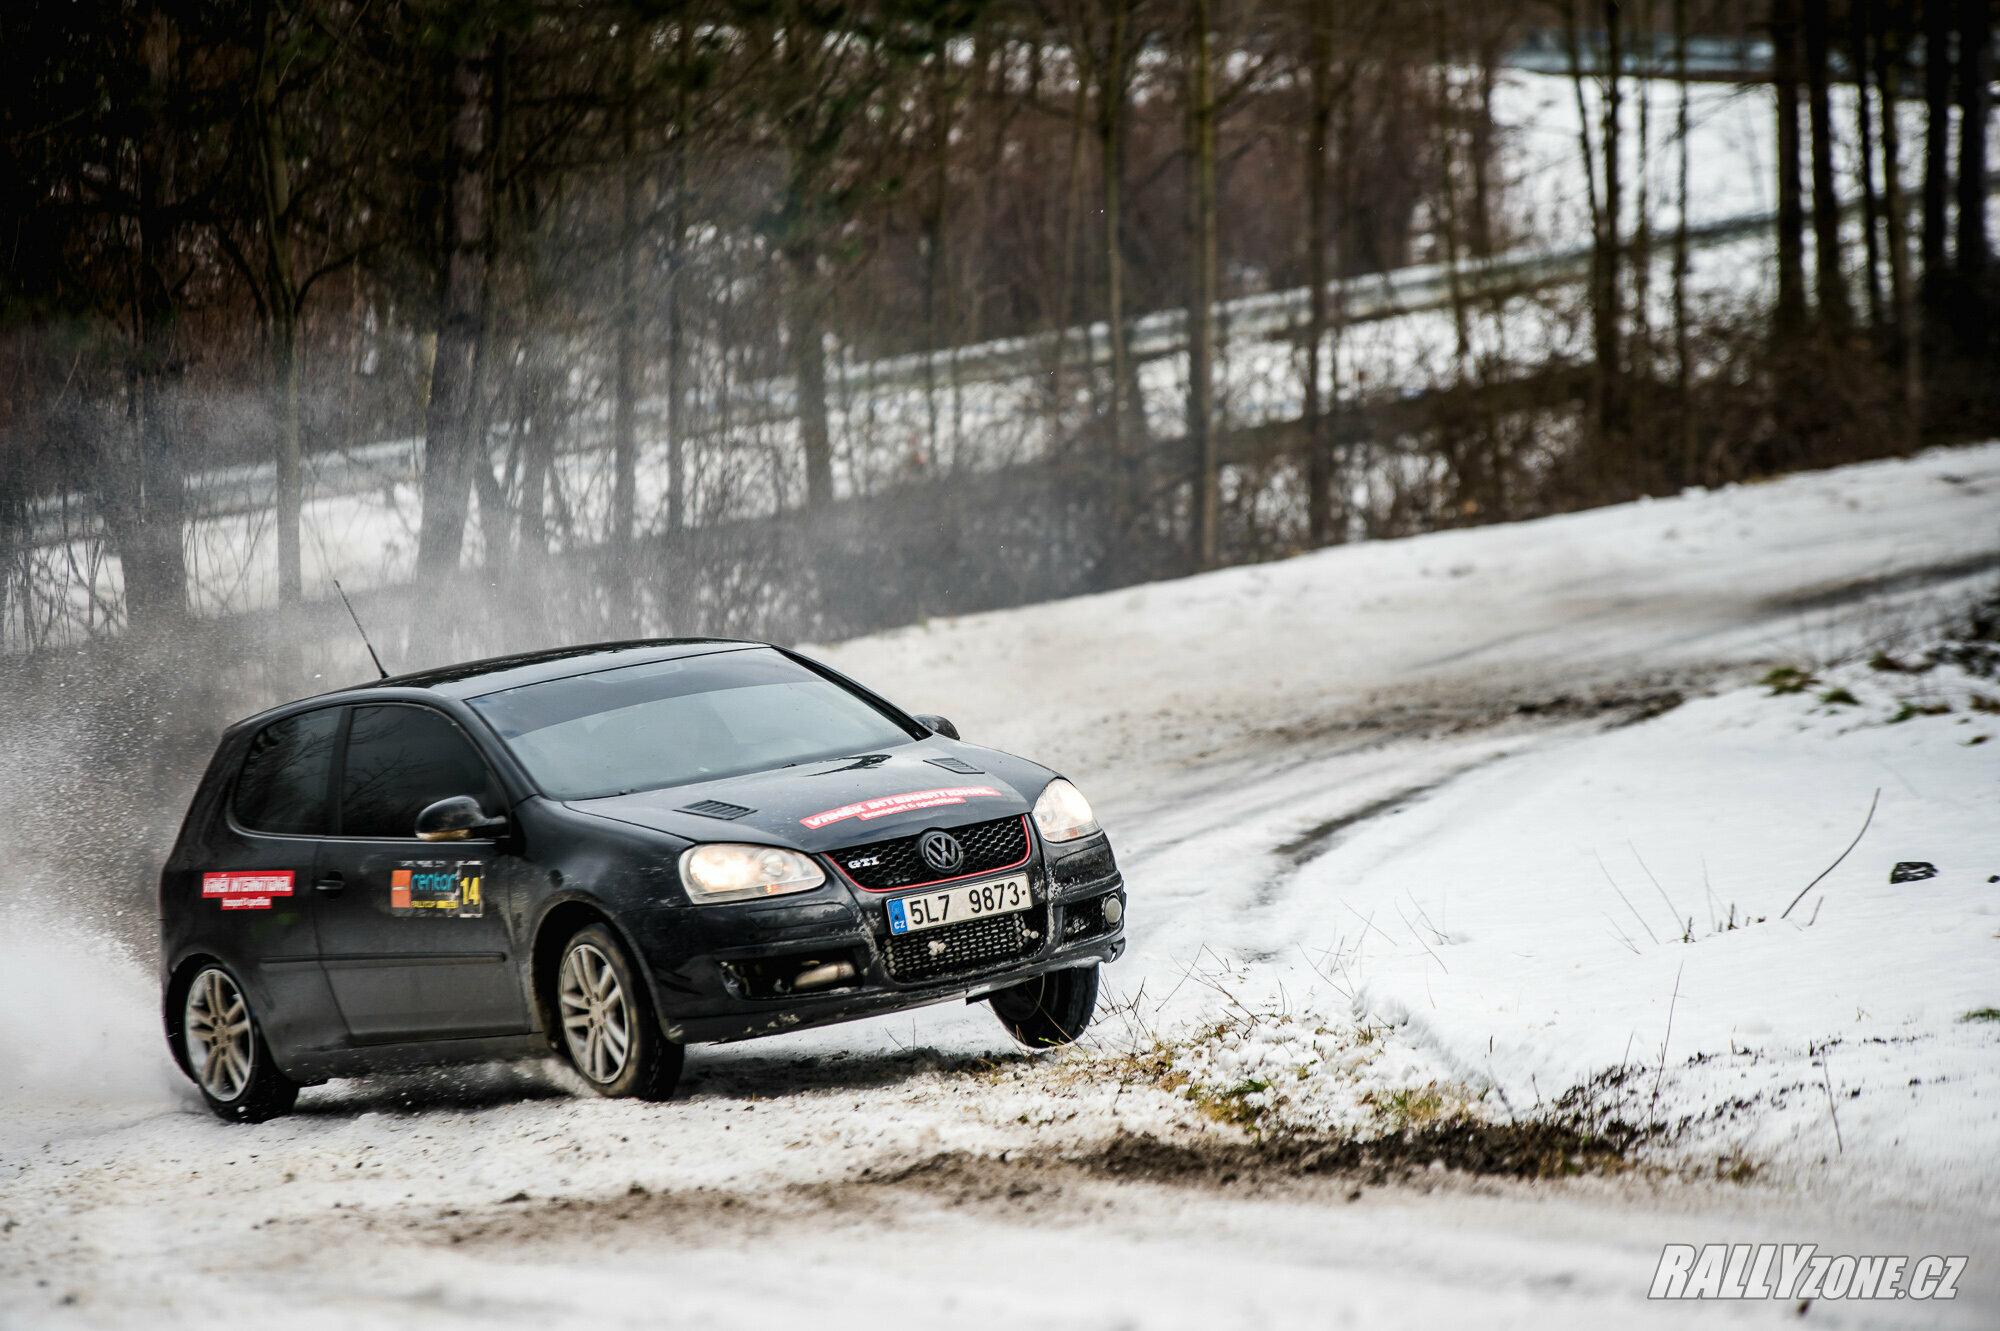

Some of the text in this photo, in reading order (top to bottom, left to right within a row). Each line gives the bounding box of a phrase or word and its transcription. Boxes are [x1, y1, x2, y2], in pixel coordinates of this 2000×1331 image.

[867, 788, 996, 809] INTERNATIONAL
[848, 856, 880, 869] GTI
[460, 877, 480, 905] 14
[909, 881, 1020, 925] 5L7 9873
[894, 920, 906, 930] CZ
